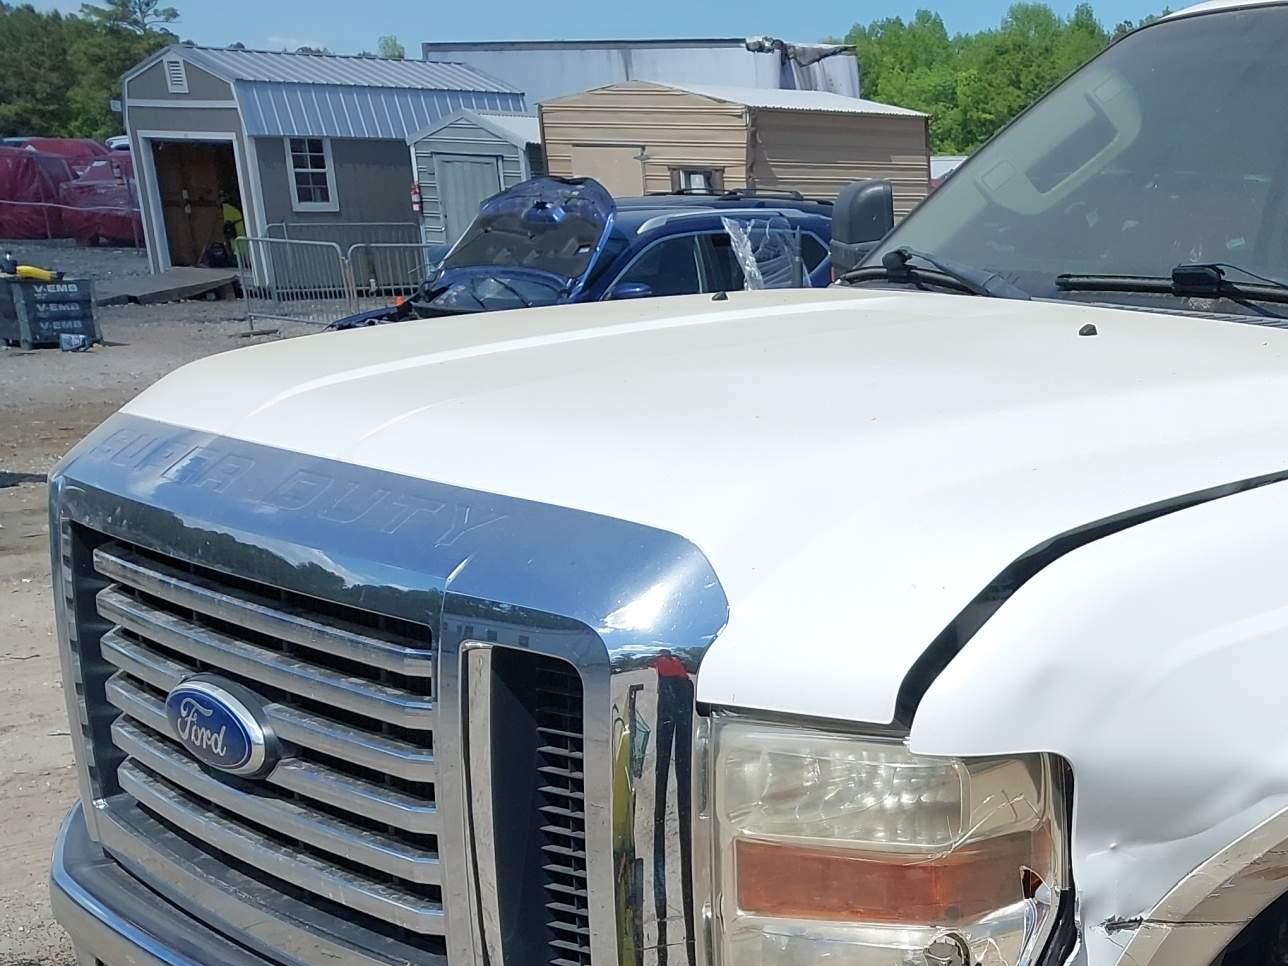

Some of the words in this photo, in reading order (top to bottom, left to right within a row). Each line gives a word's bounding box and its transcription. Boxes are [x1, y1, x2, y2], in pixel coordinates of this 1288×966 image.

[88, 427, 256, 493] SUPER
[262, 468, 510, 549] DUTY
[177, 697, 227, 757] Ford
